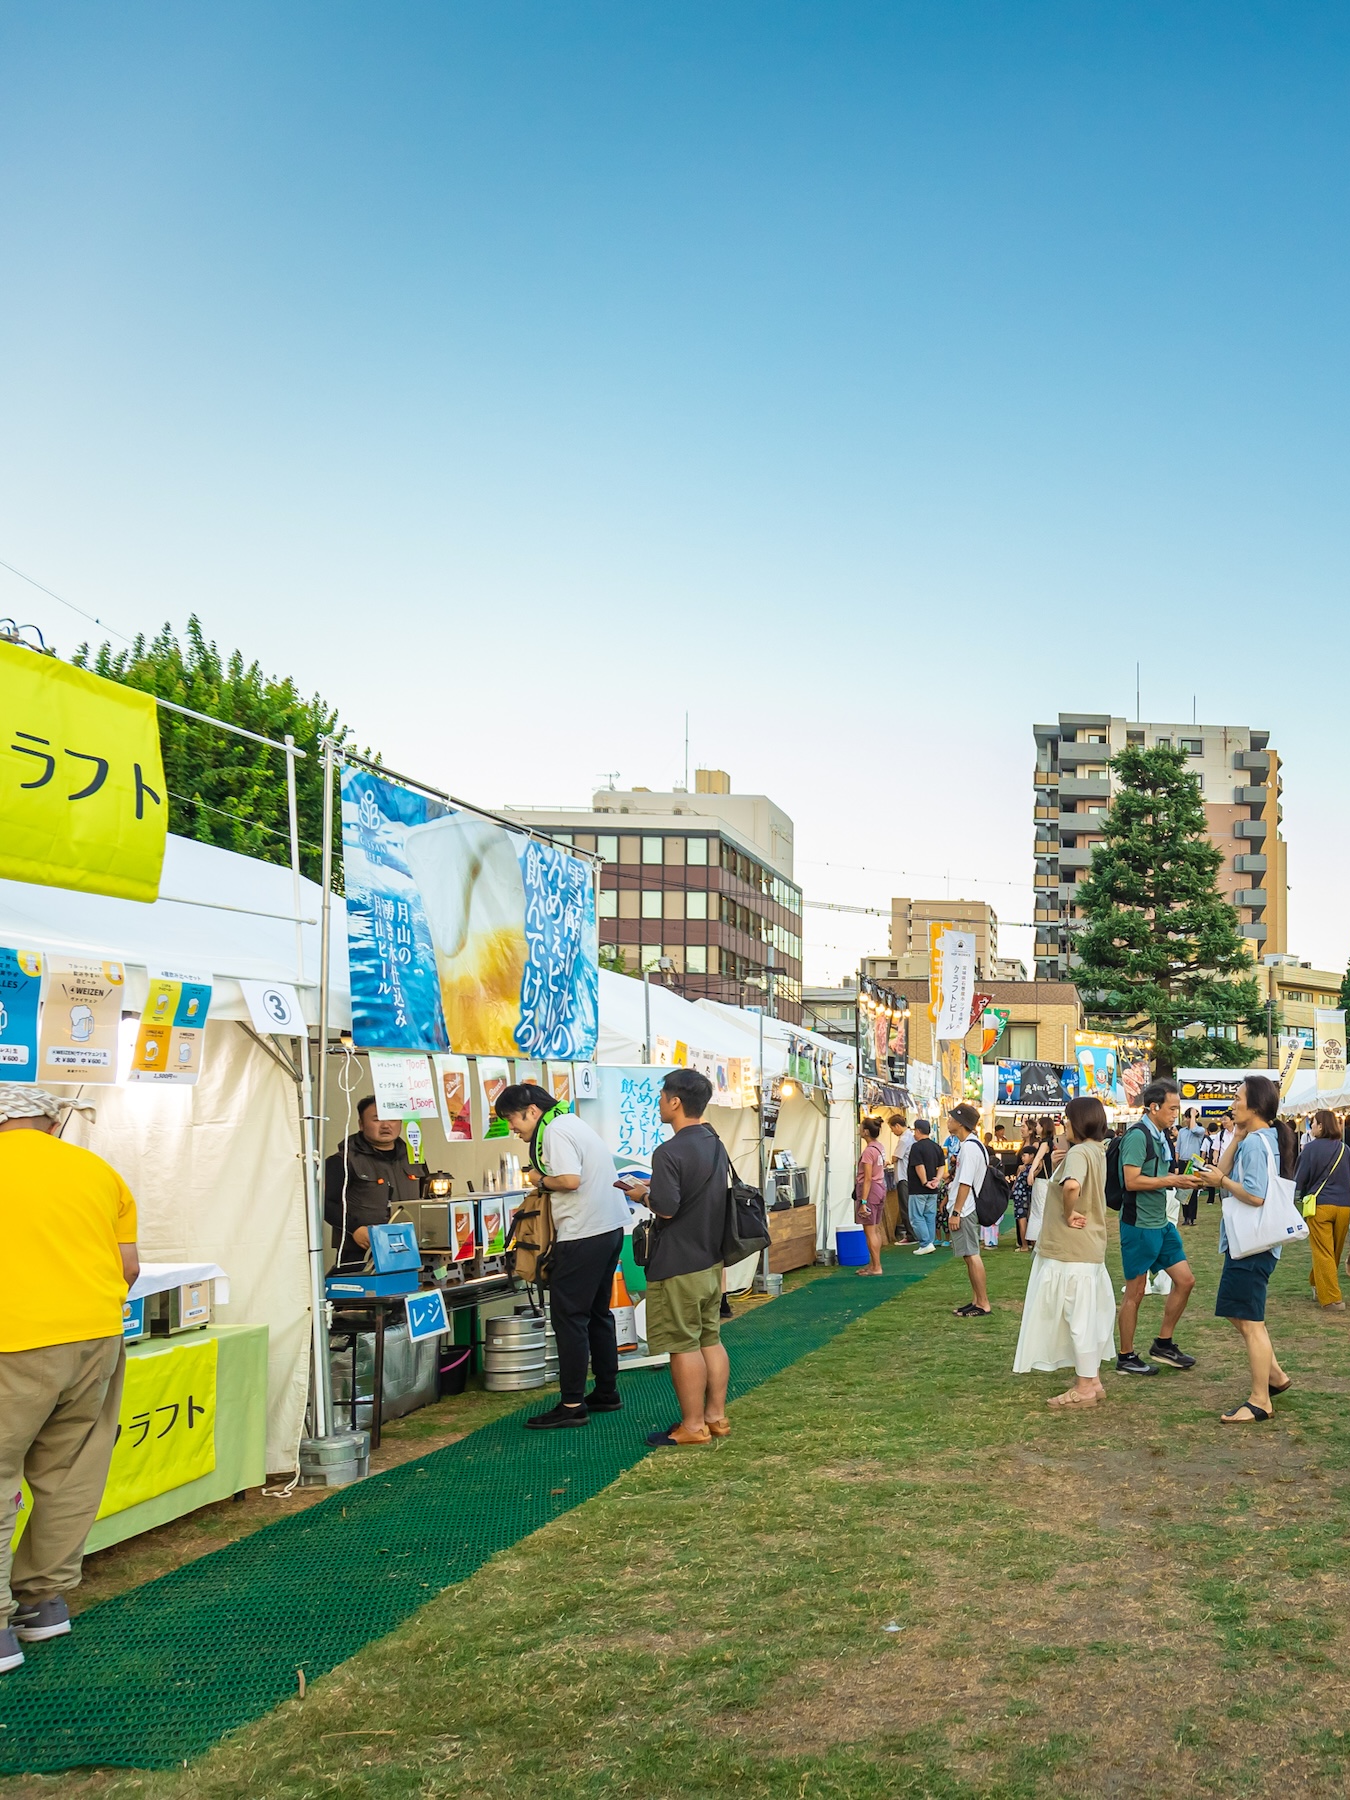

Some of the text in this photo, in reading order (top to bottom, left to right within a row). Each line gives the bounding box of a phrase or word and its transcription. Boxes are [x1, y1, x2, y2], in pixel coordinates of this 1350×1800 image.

[11, 731, 160, 820] ラフト
[373, 893, 391, 996] 月山ビール
[382, 898, 408, 1028] 湧き水仕込み
[397, 901, 412, 965] 月山の
[515, 844, 548, 1048] 飲んでけろ
[945, 965, 960, 1031] クラフトビール
[617, 1078, 639, 1156] 飲んでけろ
[1196, 1083, 1240, 1093] クラフトビ
[413, 1298, 441, 1328] レジ
